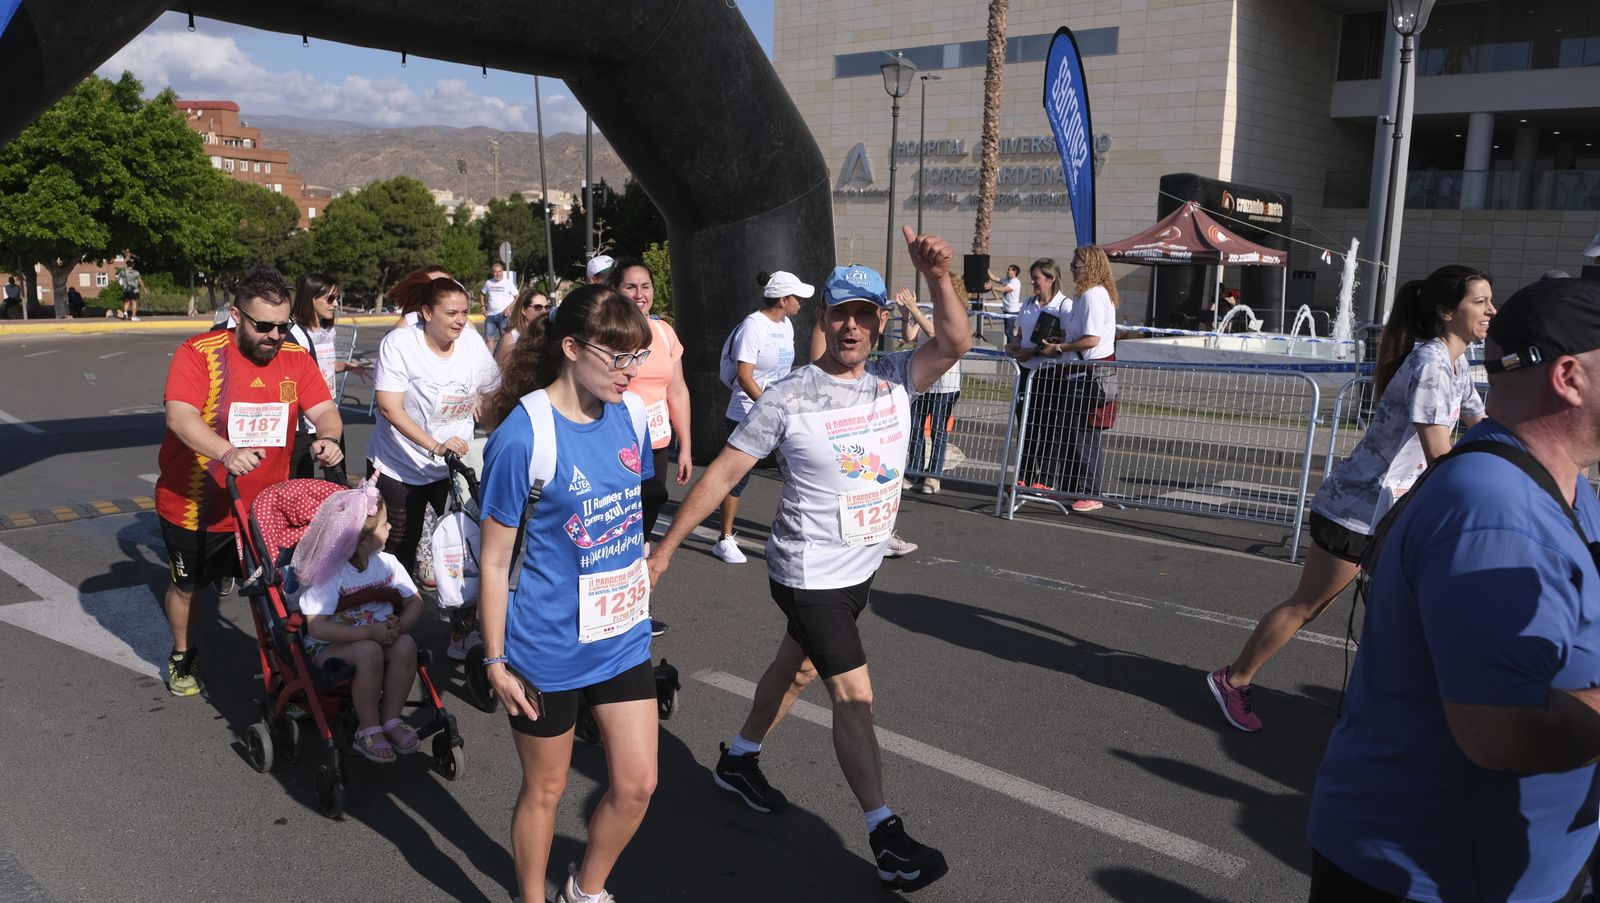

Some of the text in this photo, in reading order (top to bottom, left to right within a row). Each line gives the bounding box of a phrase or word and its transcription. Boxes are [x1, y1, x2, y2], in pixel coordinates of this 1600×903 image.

[897, 138, 967, 157] HOSPITAL
[922, 165, 1067, 187] TORRERDENA
[441, 403, 474, 415] 1188
[236, 418, 281, 432] 1187
[568, 479, 592, 492] ALTEA
[582, 498, 593, 517] II
[593, 491, 622, 510] Runner
[604, 502, 625, 523] azul
[854, 496, 899, 528] 1234
[595, 574, 627, 586] CARRERA
[595, 579, 646, 617] 1235
